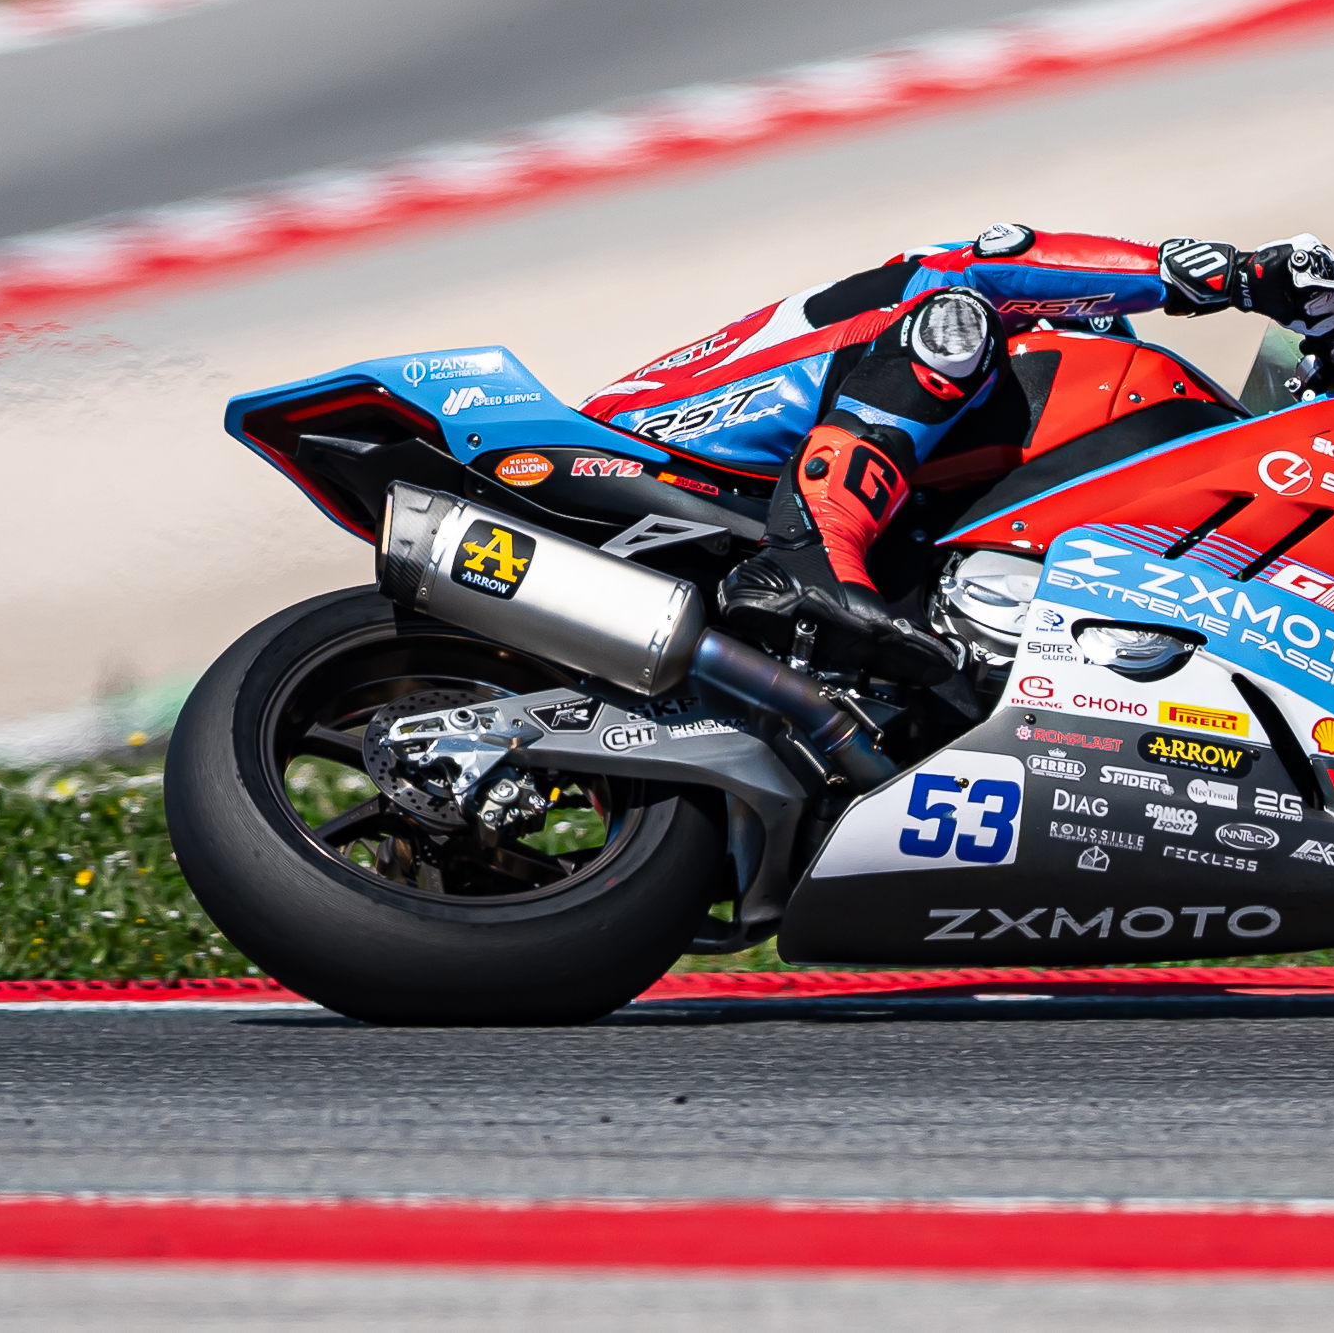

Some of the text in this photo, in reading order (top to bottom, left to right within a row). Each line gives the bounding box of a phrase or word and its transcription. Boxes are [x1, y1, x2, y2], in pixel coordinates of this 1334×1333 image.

[998, 292, 1116, 315] RST
[430, 369, 472, 380] INDUSTRIA
[473, 393, 542, 407] SPEED SERVICE
[632, 374, 786, 442] RST
[663, 403, 786, 443] race dept
[501, 462, 548, 475] NALDONI
[509, 457, 539, 465] MOLINO
[570, 457, 644, 477] KYB
[461, 570, 510, 594] ARROW
[1045, 569, 1233, 638] EXTREME
[1027, 641, 1073, 654] SUTER
[1042, 654, 1078, 662] CLUTCH
[627, 696, 700, 722] SKF
[1011, 698, 1063, 710] DEGANG
[1072, 694, 1148, 717] CHOHO
[1169, 706, 1238, 731] PIRELLI
[611, 725, 657, 747] CHT
[1032, 727, 1124, 753] ROMPLAST
[1148, 736, 1243, 769] ARROW
[1031, 757, 1082, 774] PERREL
[1159, 757, 1229, 774] EXHAUST
[1099, 765, 1168, 793] SPIDER
[1052, 788, 1109, 818] DIAG
[1189, 785, 1237, 802] MecTronik
[1253, 787, 1304, 816] 2G
[898, 773, 1022, 864] 53
[1144, 803, 1198, 825] SAMCO
[1255, 809, 1304, 822] PRINTING
[1050, 820, 1145, 847] ROUSSILLE
[1158, 819, 1194, 834] sport
[924, 904, 1281, 942] ZXMOTO
